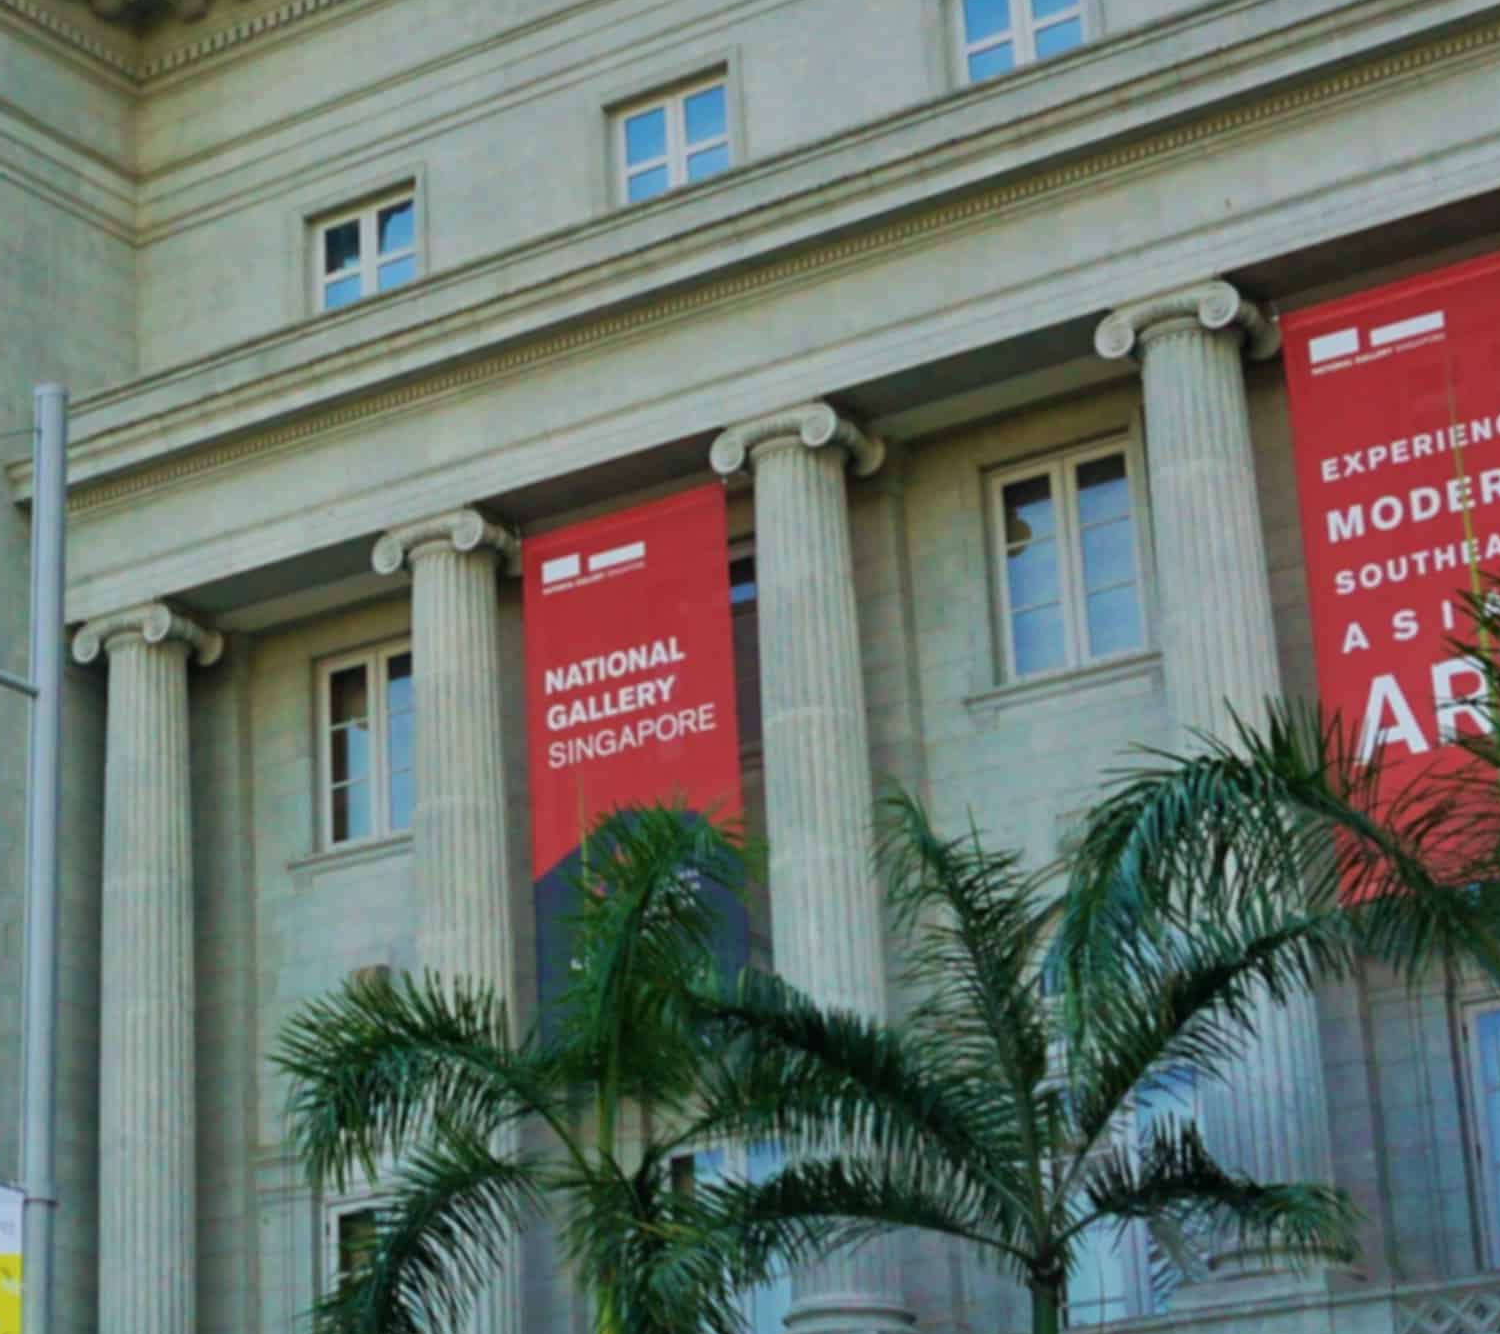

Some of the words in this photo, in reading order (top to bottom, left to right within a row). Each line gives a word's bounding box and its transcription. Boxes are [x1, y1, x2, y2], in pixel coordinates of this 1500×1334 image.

[545, 636, 686, 696] NATIONAL
[547, 674, 676, 731] GALLERY
[548, 702, 718, 769] SINGAPORE
